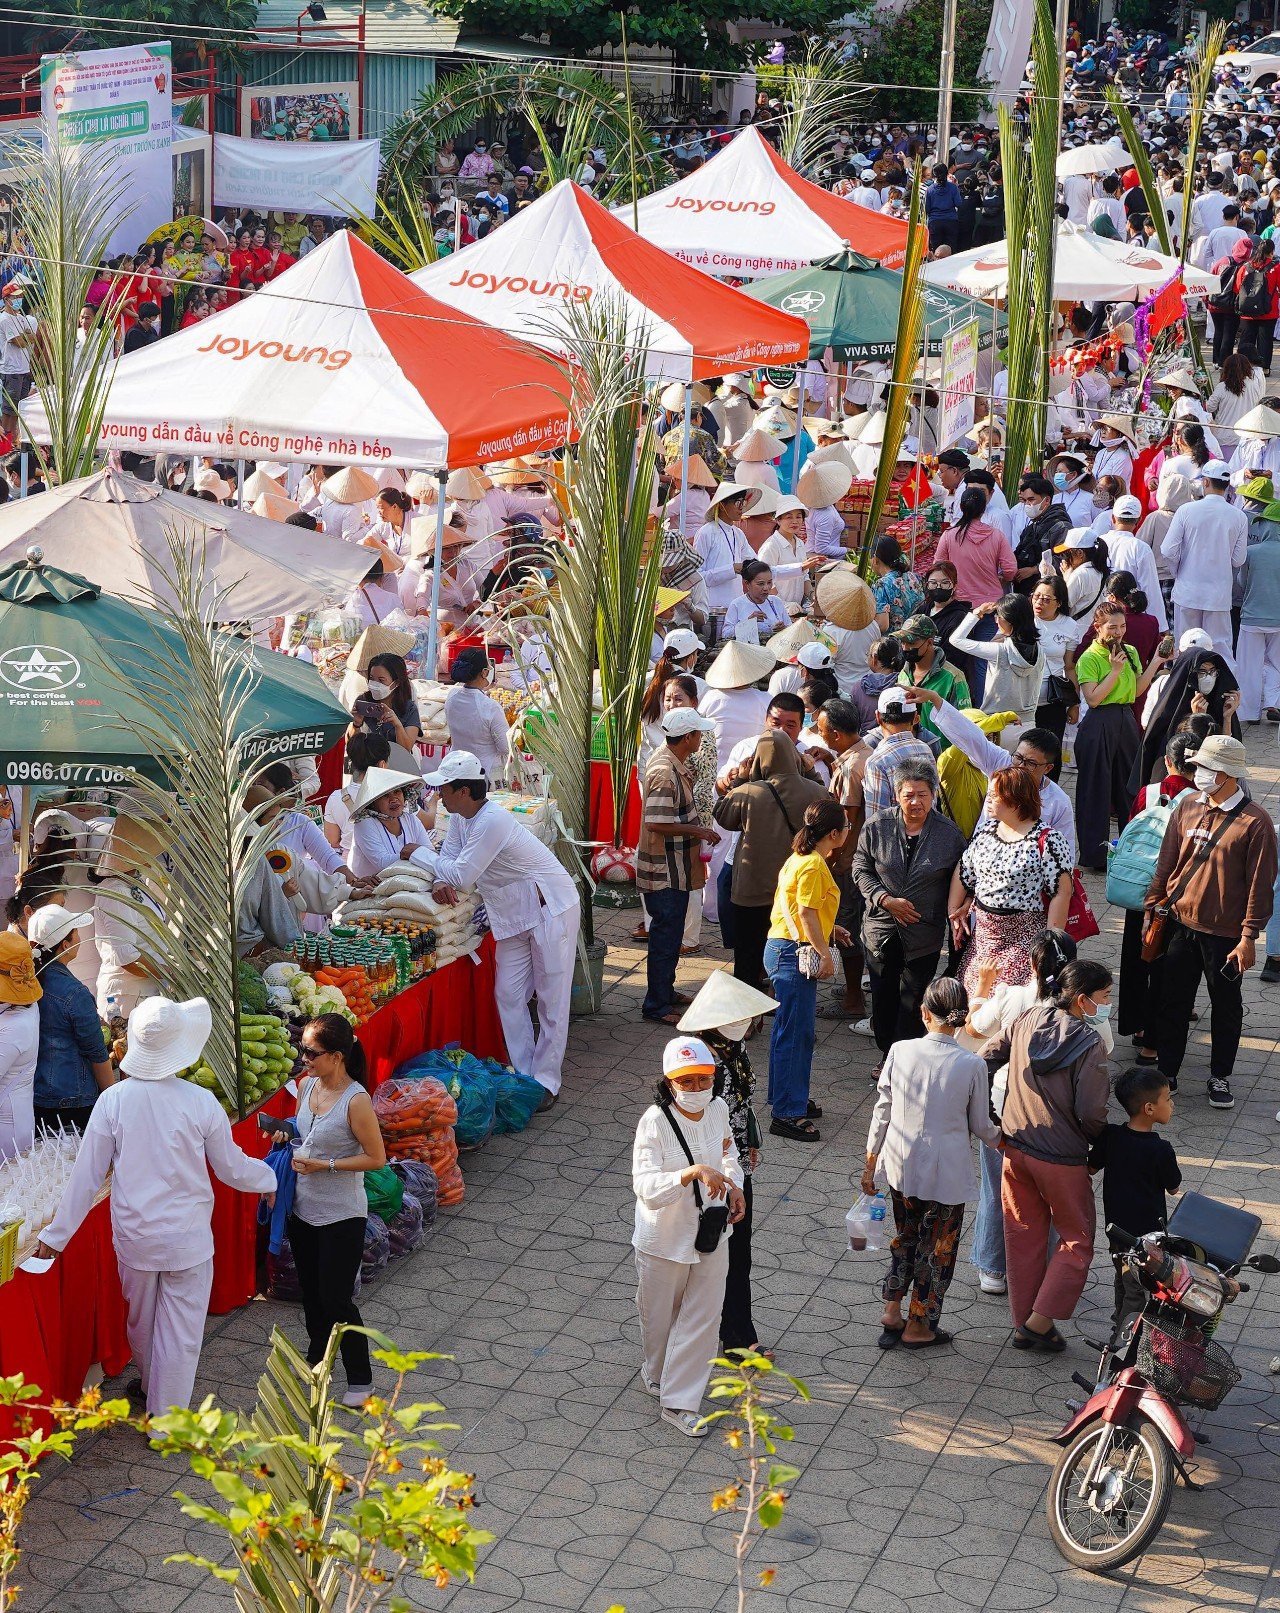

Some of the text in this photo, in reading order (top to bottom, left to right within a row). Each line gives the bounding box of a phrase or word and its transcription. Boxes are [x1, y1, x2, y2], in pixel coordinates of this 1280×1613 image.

[666, 197, 776, 215] Joyoung
[696, 251, 709, 264] về
[713, 253, 742, 268] Công
[746, 257, 773, 270] nghệ
[449, 270, 593, 303] Joyoung
[197, 334, 352, 370] Joyoung
[844, 347, 869, 357] VIVA
[152, 421, 179, 441] dẫn
[184, 423, 212, 443] đầu
[217, 425, 234, 445] về
[239, 430, 279, 452] Công
[285, 435, 323, 456] nghệ
[328, 439, 357, 455] nhà
[362, 438, 392, 459] bếp
[477, 436, 513, 457] Joyoung
[13, 664, 63, 672] VIVA
[7, 691, 30, 699] best
[33, 691, 67, 699] coffee
[270, 731, 325, 754] COFFEE
